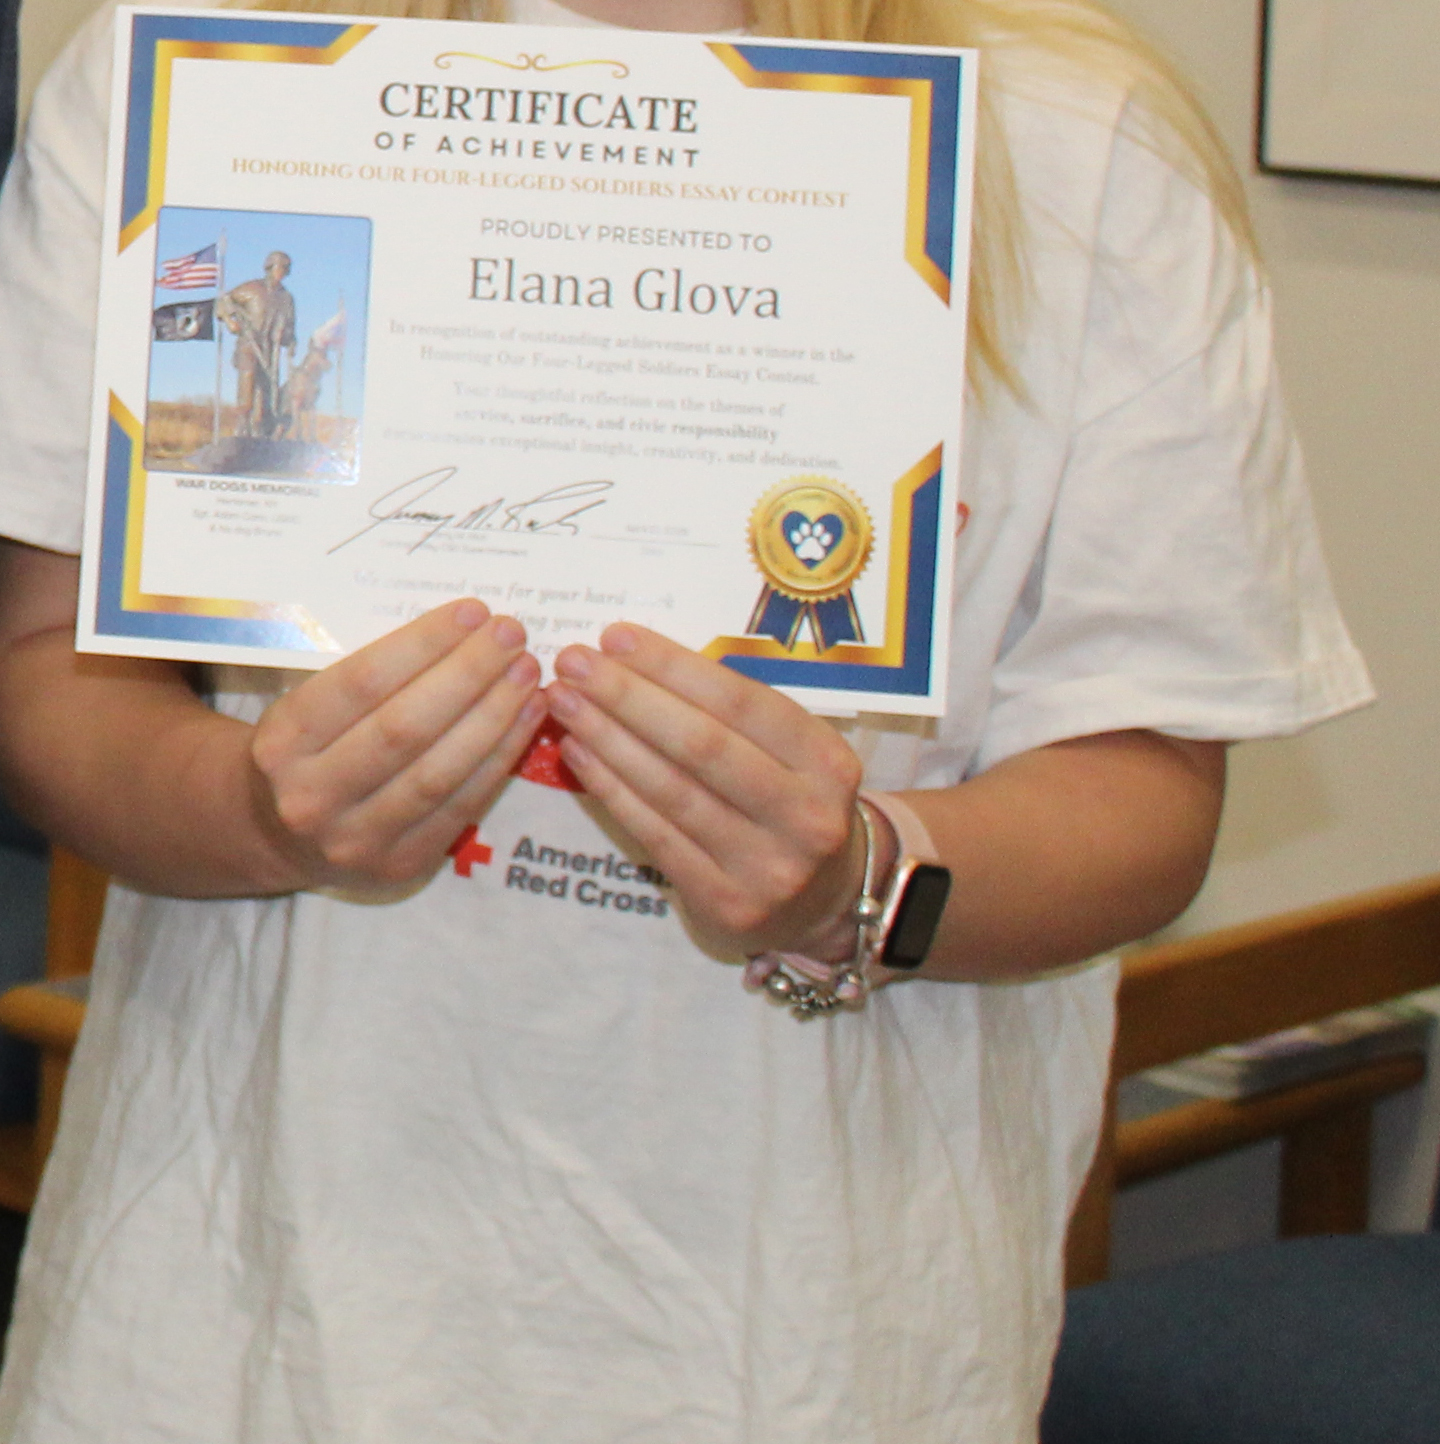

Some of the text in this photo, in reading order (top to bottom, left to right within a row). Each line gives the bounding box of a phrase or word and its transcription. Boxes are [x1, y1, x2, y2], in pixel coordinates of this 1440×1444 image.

[378, 79, 699, 134] CERTIFICATE
[373, 130, 700, 169] OF ACHIEVEMENT
[234, 154, 849, 208] HONORING OUR FOUR-LEGGED SOLDIERS ESSAY CONTEST
[478, 218, 773, 254] PROUDLY PRESENTED TO
[468, 256, 779, 318] Elana Glova
[207, 481, 247, 494] DOGS
[505, 865, 671, 917] Red Cross
